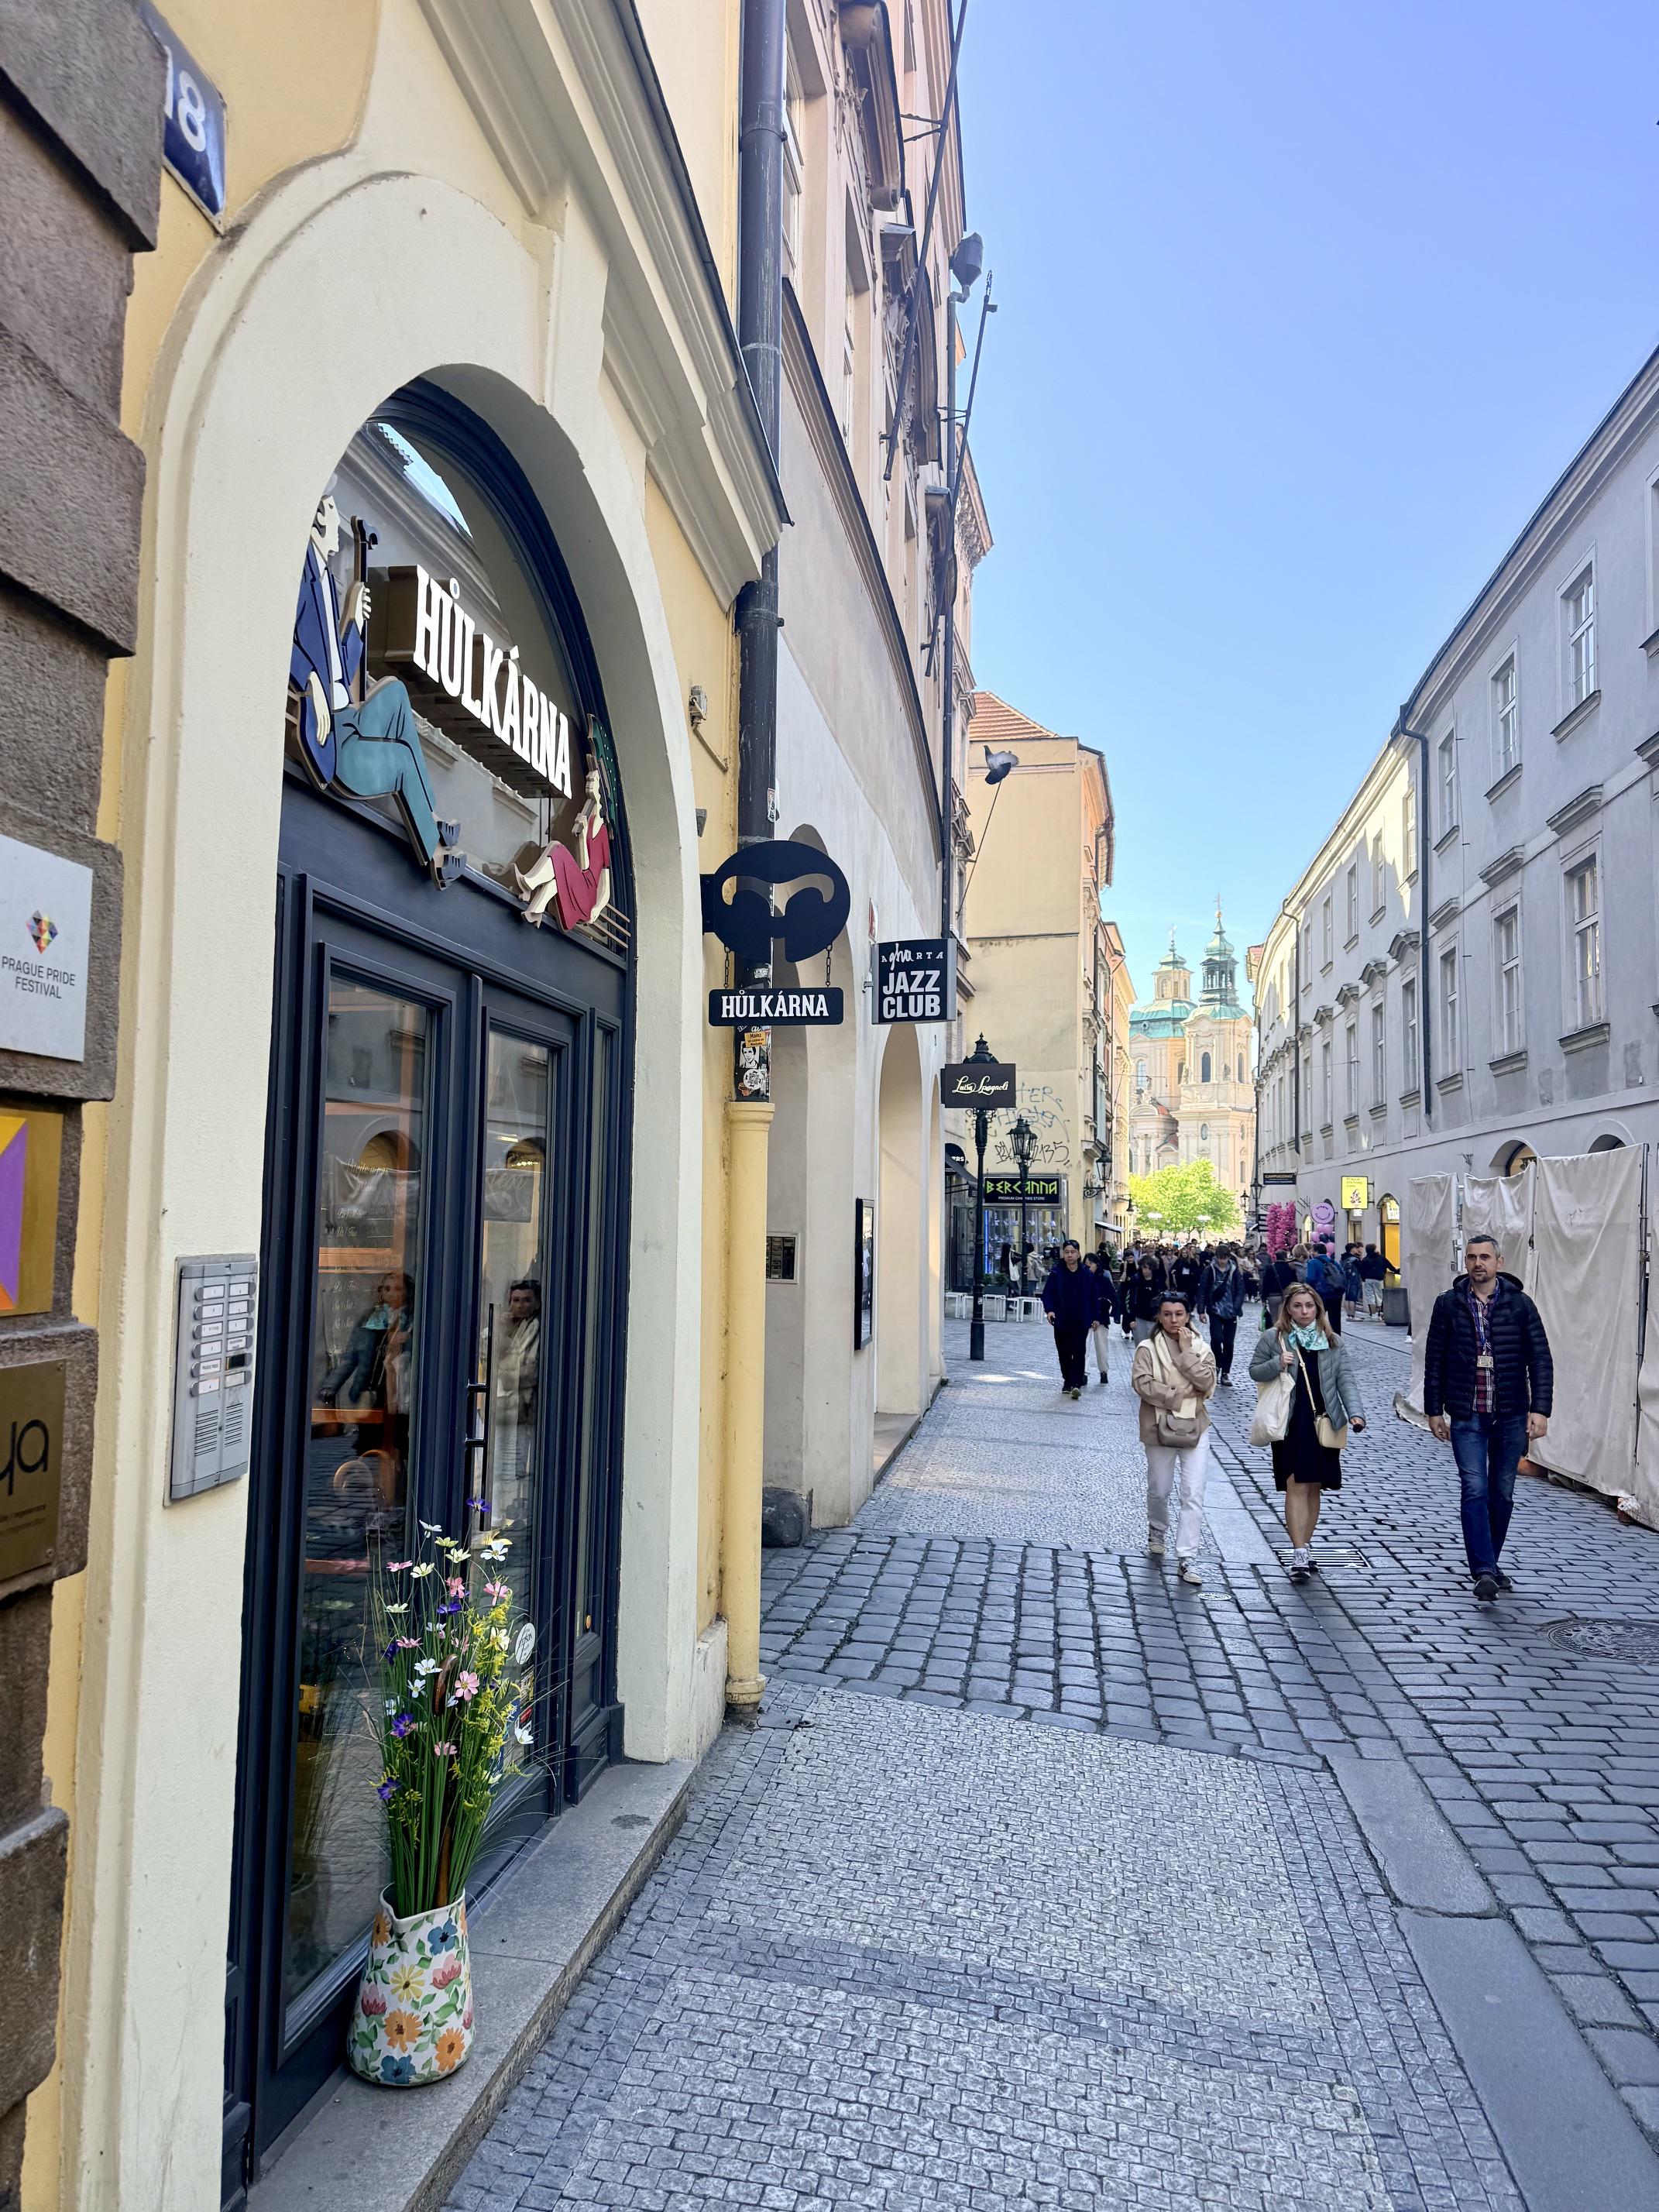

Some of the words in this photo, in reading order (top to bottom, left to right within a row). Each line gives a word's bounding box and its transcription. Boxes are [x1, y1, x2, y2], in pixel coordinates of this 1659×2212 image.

[413, 565, 572, 800] HŮLKÁRNA
[1, 956, 44, 979] PRAGUE
[46, 967, 76, 987] PRIDE
[883, 970, 941, 995] JAZZ
[15, 976, 62, 999] FESTIVAL
[721, 989, 830, 1019] HŮLKÁRNA
[883, 994, 941, 1019] CLUB
[952, 1075, 977, 1094] Luisa
